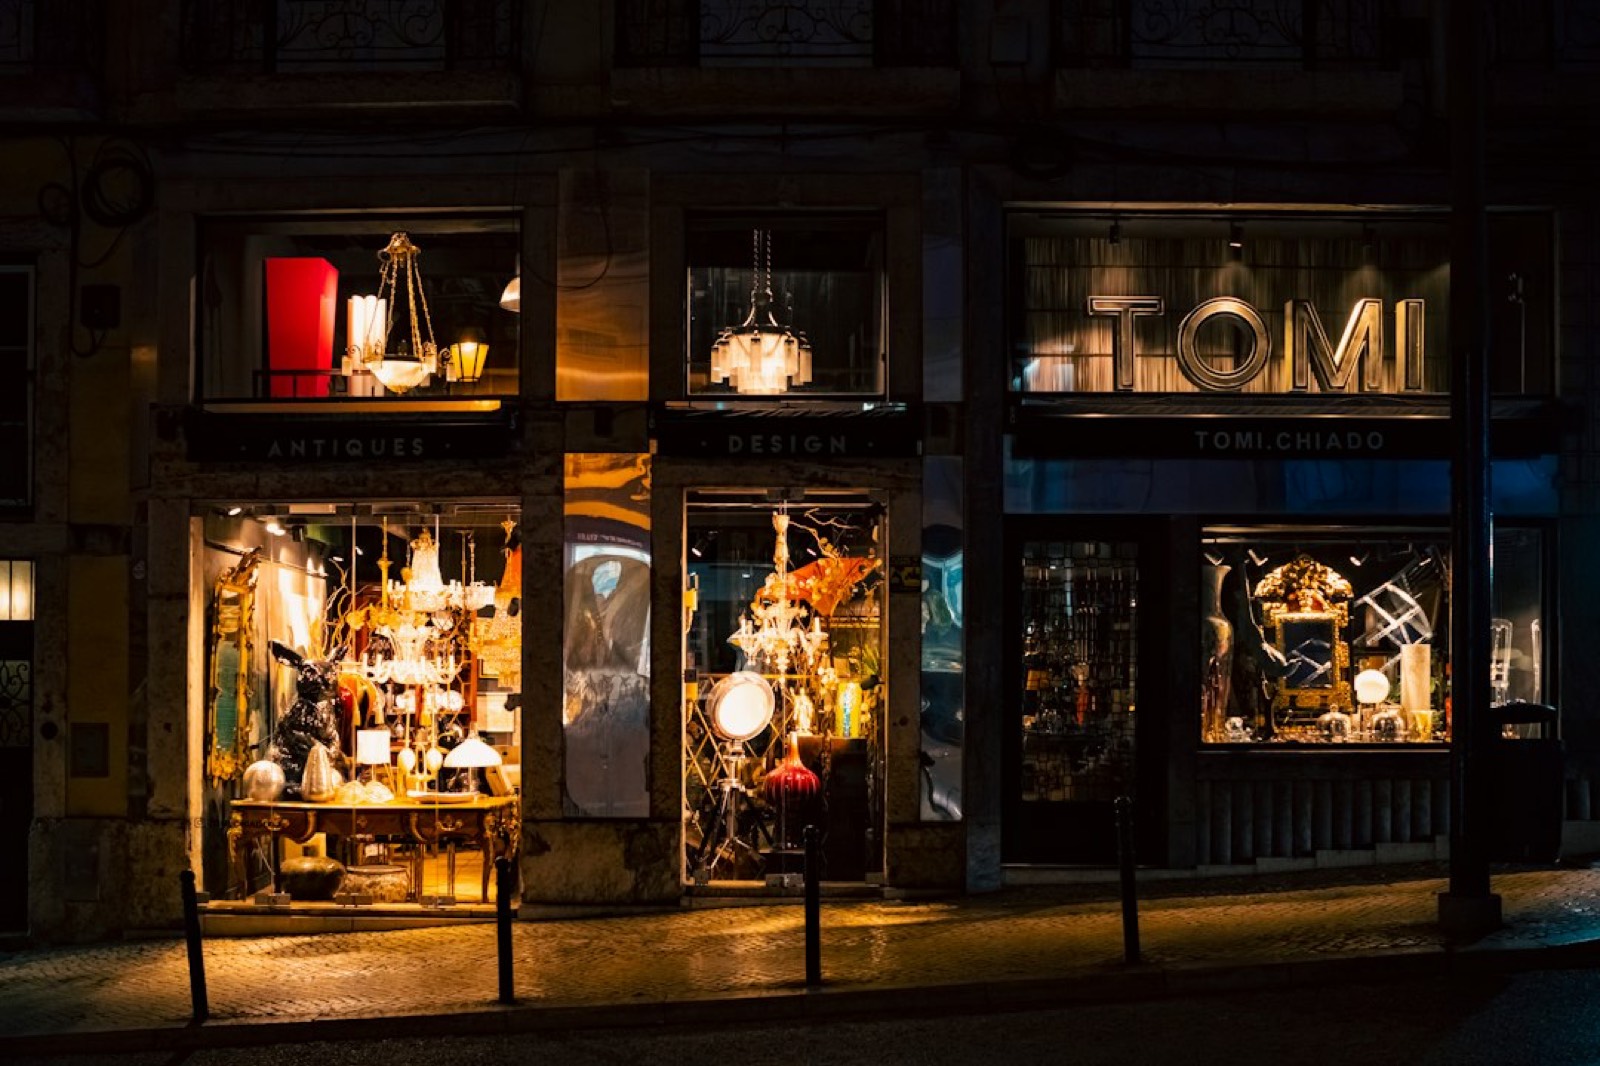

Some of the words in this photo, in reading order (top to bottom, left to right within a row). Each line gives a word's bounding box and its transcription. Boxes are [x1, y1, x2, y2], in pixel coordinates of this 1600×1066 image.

[1087, 296, 1425, 392] TOMI
[267, 437, 424, 457] ANTIQUES
[727, 433, 847, 454] DESIGN
[1193, 430, 1385, 450] TOMI.CHIADO
